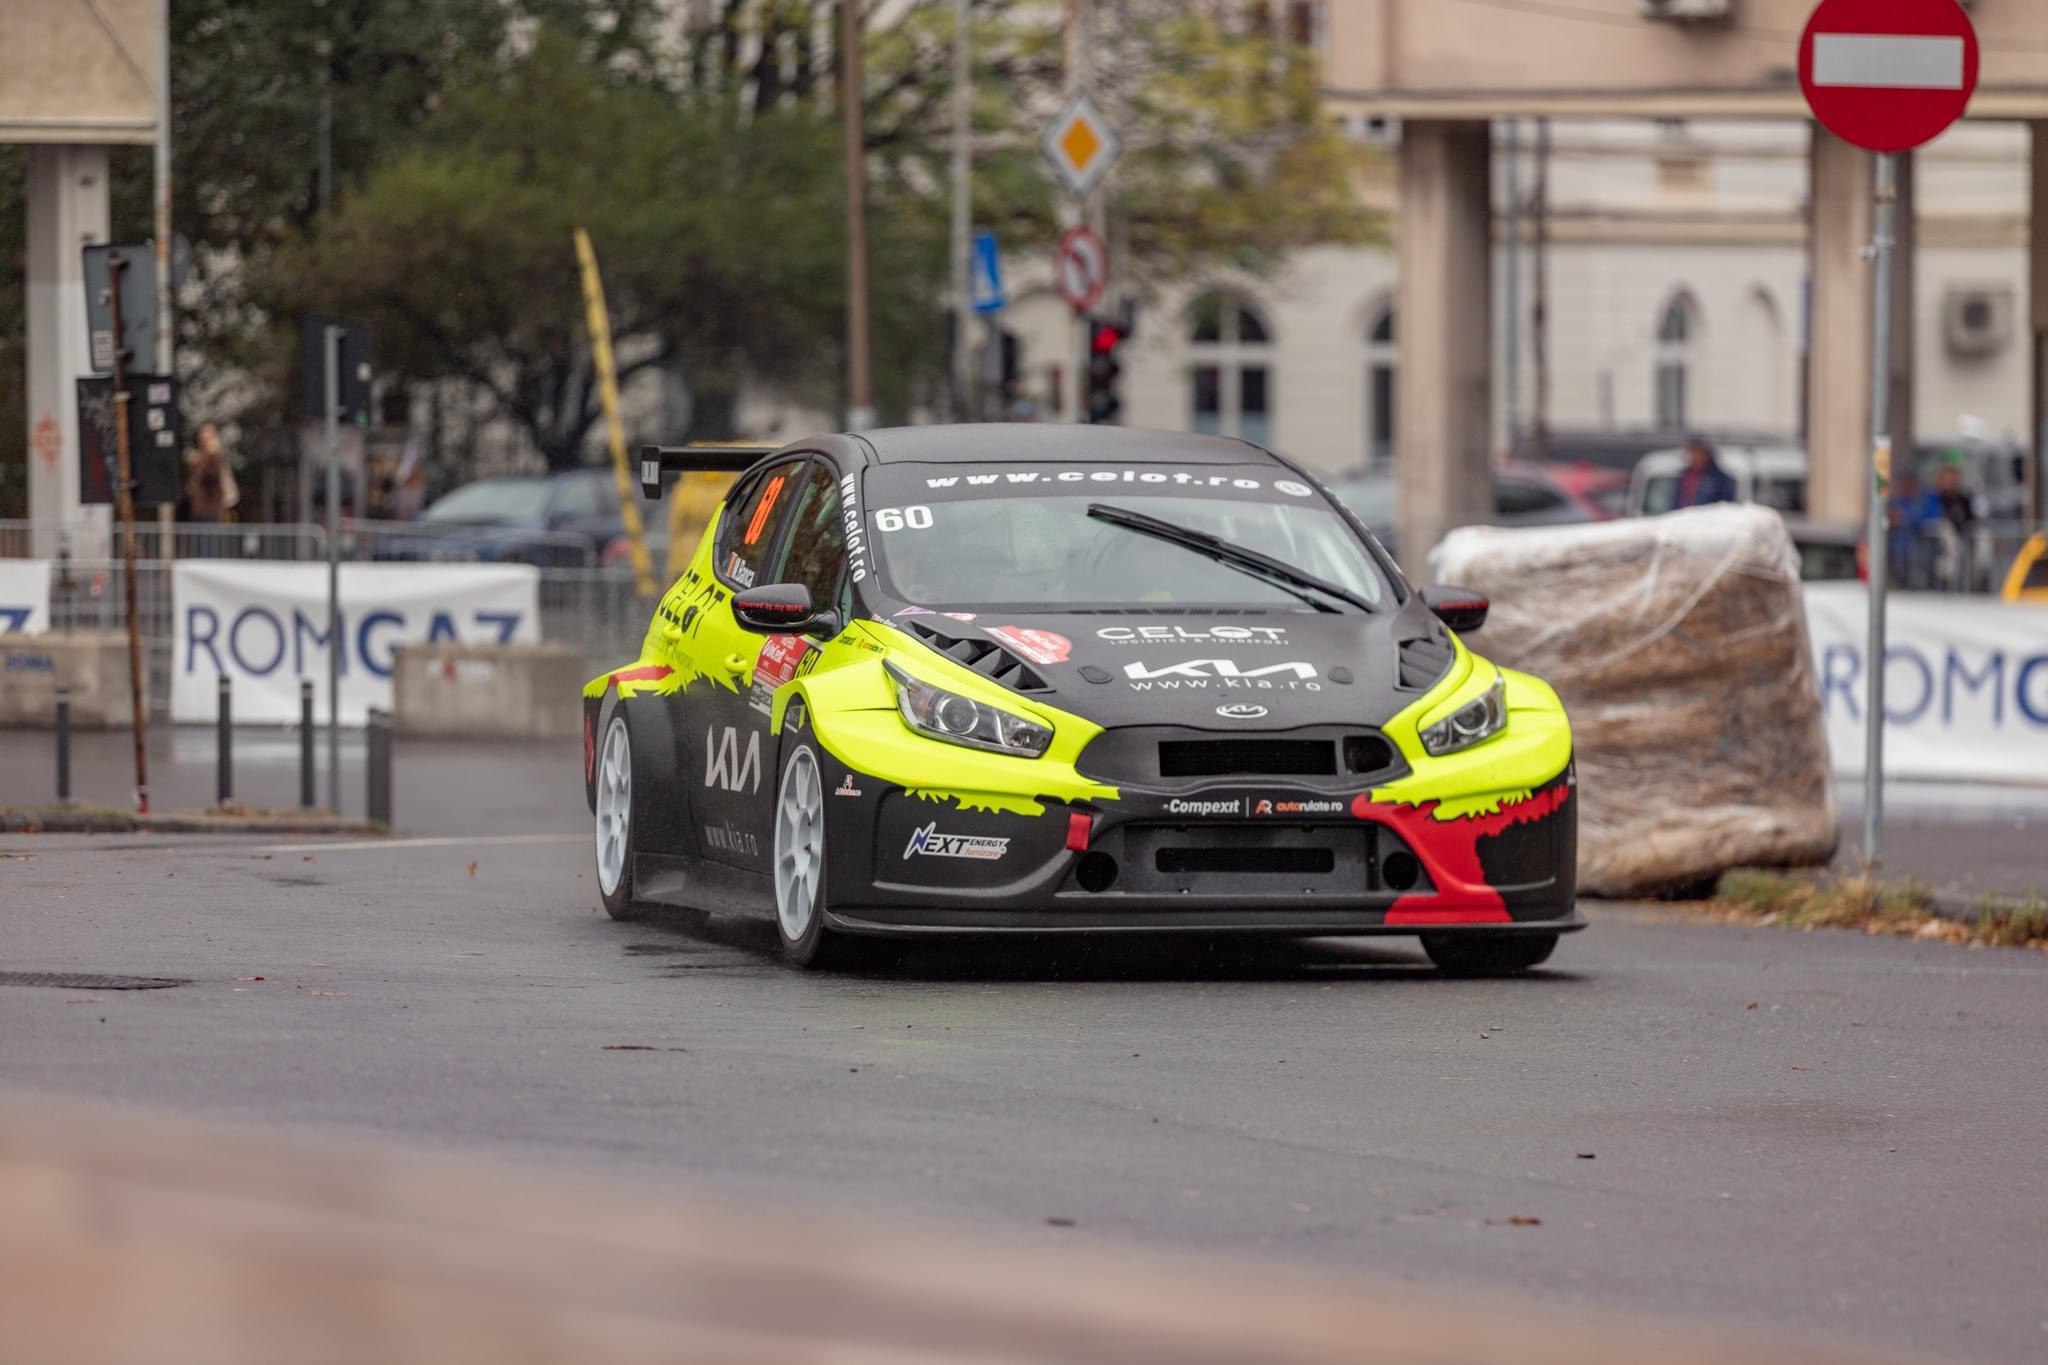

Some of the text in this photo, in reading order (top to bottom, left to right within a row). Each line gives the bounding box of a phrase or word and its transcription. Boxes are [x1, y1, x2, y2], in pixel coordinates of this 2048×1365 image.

[926, 470, 1260, 489] www.celot.ro
[744, 477, 785, 544] 60
[875, 505, 934, 533] 60
[841, 473, 866, 583] www.celot.ro
[1096, 626, 1286, 640] CELOT
[1123, 659, 1318, 680] KIA
[1129, 677, 1321, 692] www.kia.ro
[705, 724, 762, 795] KIA
[1169, 798, 1240, 816] Compexit
[1276, 799, 1343, 812] autorulate.ro
[703, 821, 758, 857] www.kia.ro
[903, 821, 1005, 860] NEXT ENERGY
